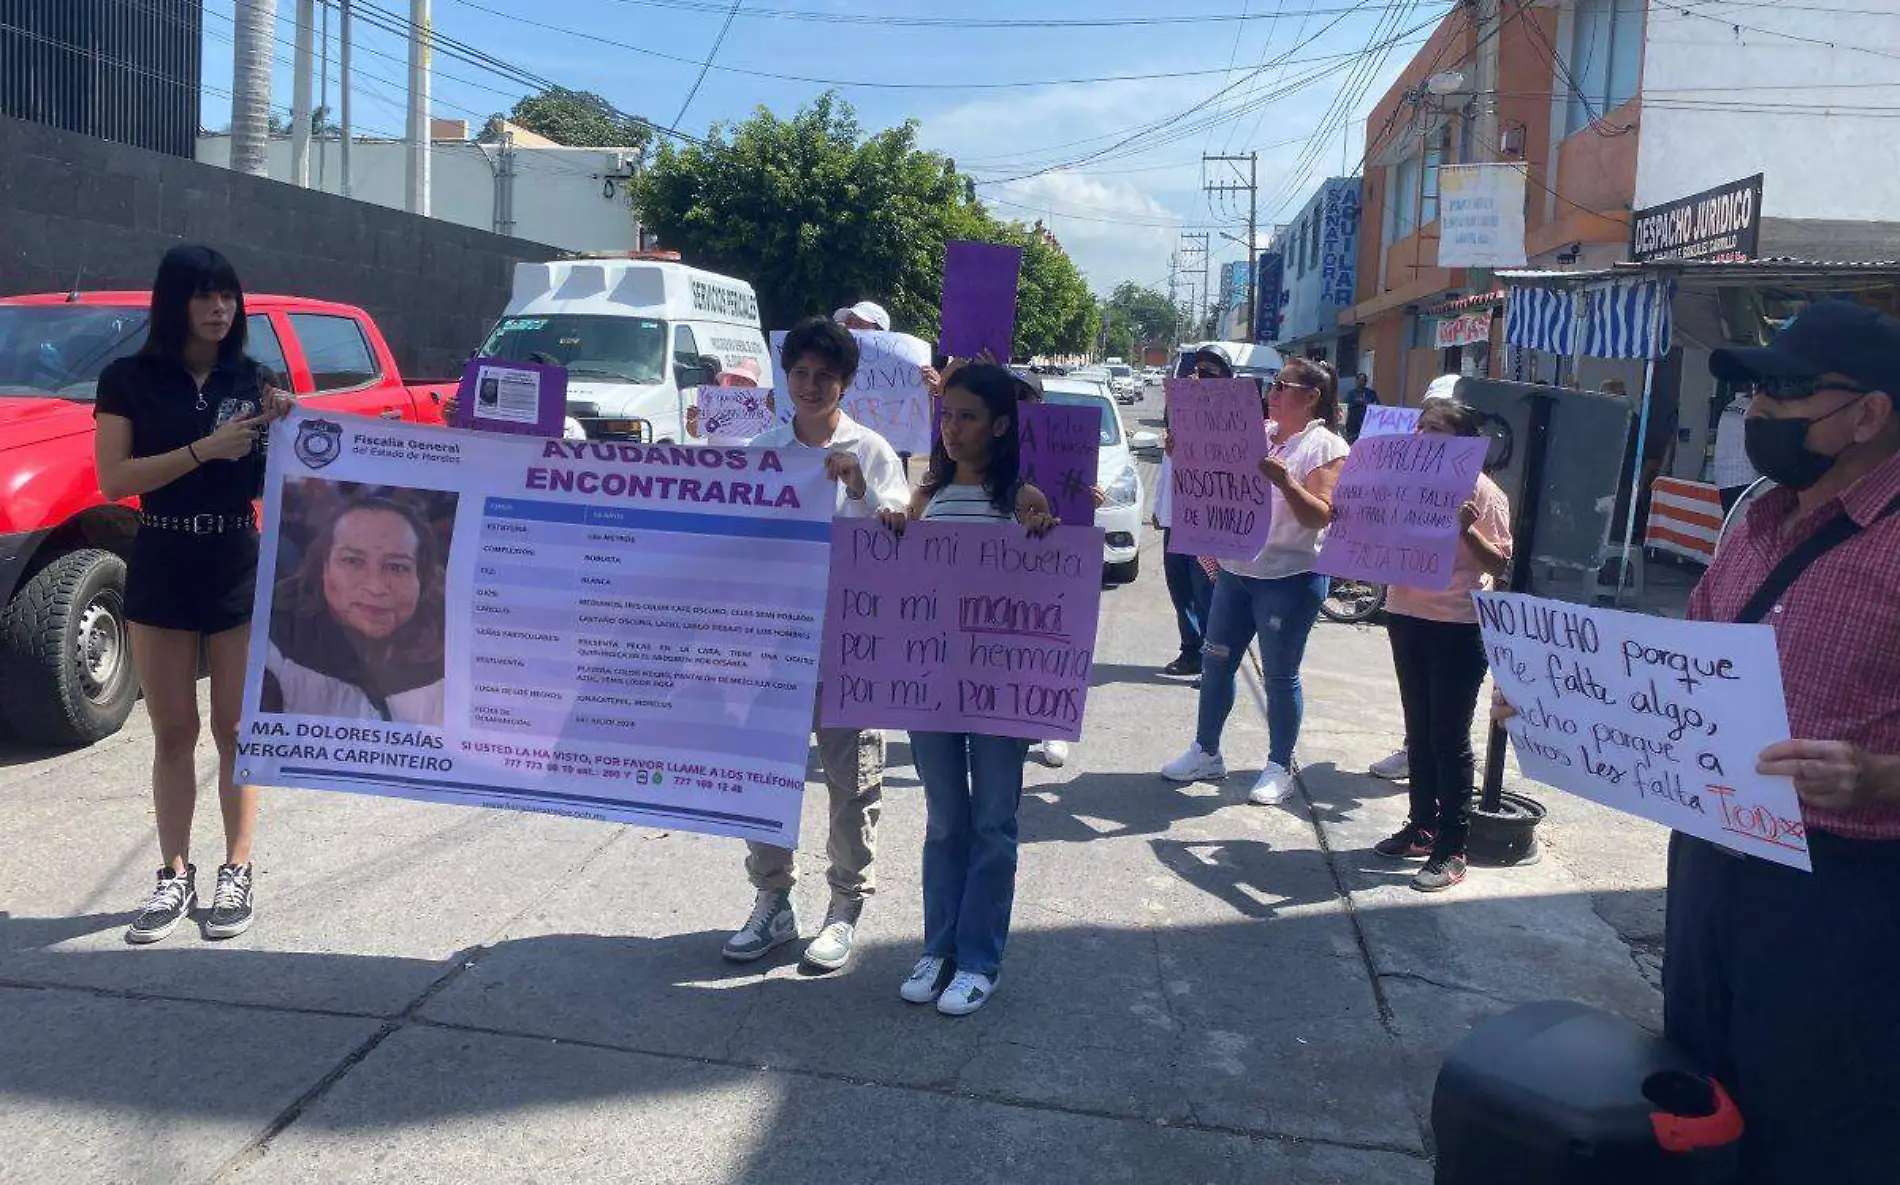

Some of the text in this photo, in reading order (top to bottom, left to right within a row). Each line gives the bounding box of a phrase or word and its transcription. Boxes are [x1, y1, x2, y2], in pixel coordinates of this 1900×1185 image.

[1635, 205, 1692, 254] DESPACHO
[408, 439, 460, 454] General
[758, 450, 783, 472] A
[525, 467, 800, 508] ENCONTRARLA
[1173, 469, 1265, 505] NOSOTRAS
[1183, 505, 1200, 528] DE
[924, 532, 959, 567] mi
[979, 539, 1084, 578] Abuela
[900, 589, 938, 621] mi
[958, 592, 1066, 633] mamá
[907, 632, 947, 664] mi
[969, 634, 1092, 680] hermana
[1477, 597, 1740, 693] NO LUCHO porque
[1547, 654, 1617, 705] falta
[1630, 678, 1717, 740] algo,
[251, 721, 444, 750] MA. DOLORES ISAÍAS
[1592, 722, 1679, 768] porque
[1699, 753, 1724, 777] a
[237, 742, 453, 773] VERGARA CARPINTEIRO
[461, 741, 471, 751] SI
[475, 742, 512, 755] USTED
[516, 747, 530, 757] LA
[533, 749, 550, 759] HA
[553, 751, 592, 765] VISTO,
[595, 755, 620, 767] POR
[624, 758, 664, 771] FAVOR
[667, 762, 707, 776] LLAME
[709, 768, 718, 777] A
[721, 769, 744, 781] LOS
[1634, 762, 1705, 814] falta
